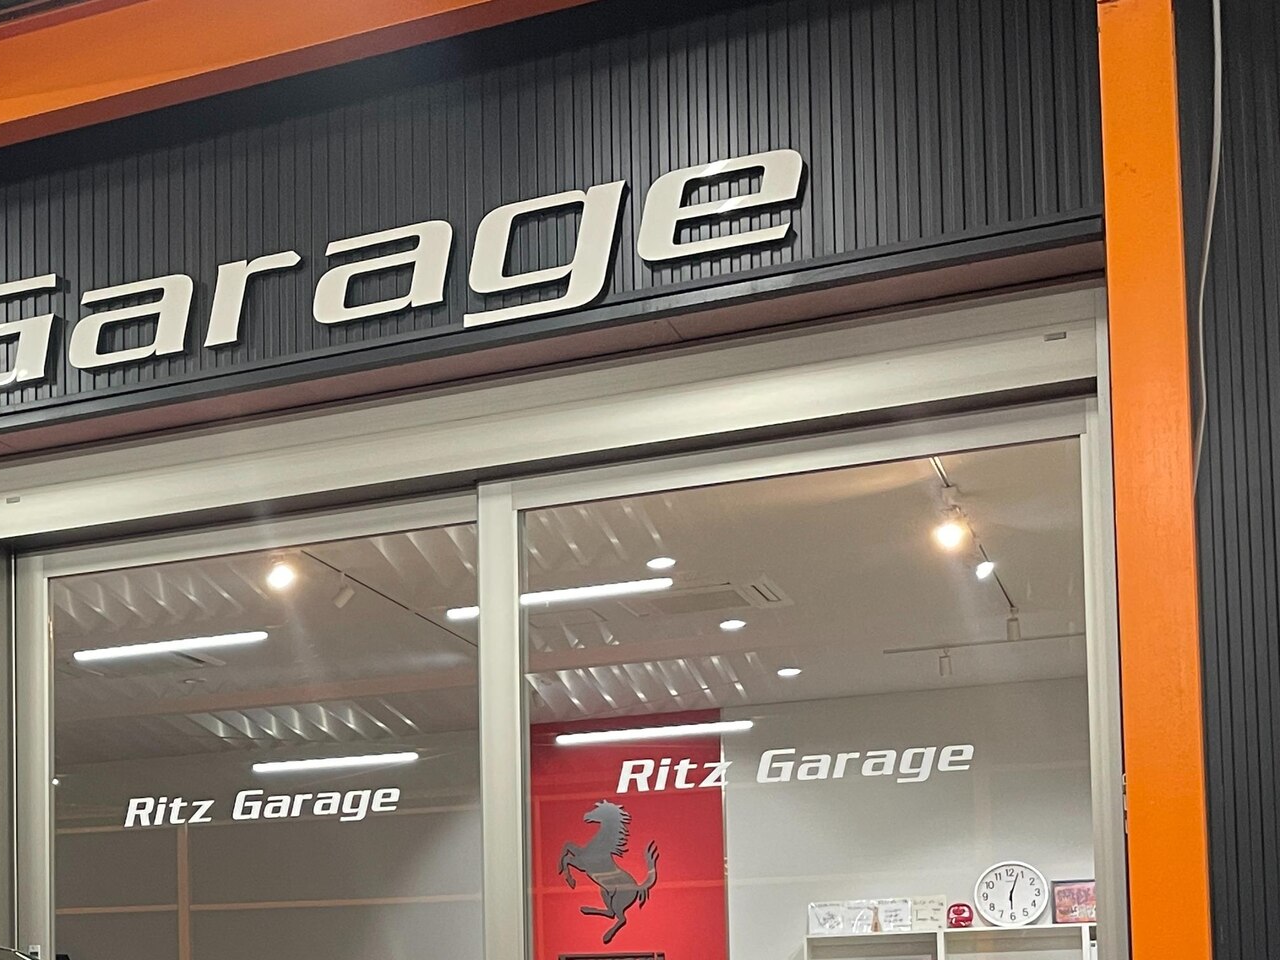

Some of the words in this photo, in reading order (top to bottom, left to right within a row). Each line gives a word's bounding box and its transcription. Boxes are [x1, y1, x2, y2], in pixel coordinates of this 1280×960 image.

[616, 757, 733, 794] Ritz
[756, 743, 975, 784] Garage
[123, 796, 215, 828] Ritz
[231, 787, 401, 822] Garage
[995, 872, 1002, 881] 11
[1006, 868, 1015, 877] 12
[1020, 870, 1025, 879] 1
[985, 881, 995, 890] 10
[1029, 877, 1035, 886] 2
[982, 892, 989, 901] 9
[1034, 888, 1041, 897] 3
[989, 903, 996, 911] 8
[1031, 899, 1037, 908] 4
[998, 910, 1004, 918] 7
[1010, 912, 1016, 921] 6
[1022, 907, 1029, 917] 5
